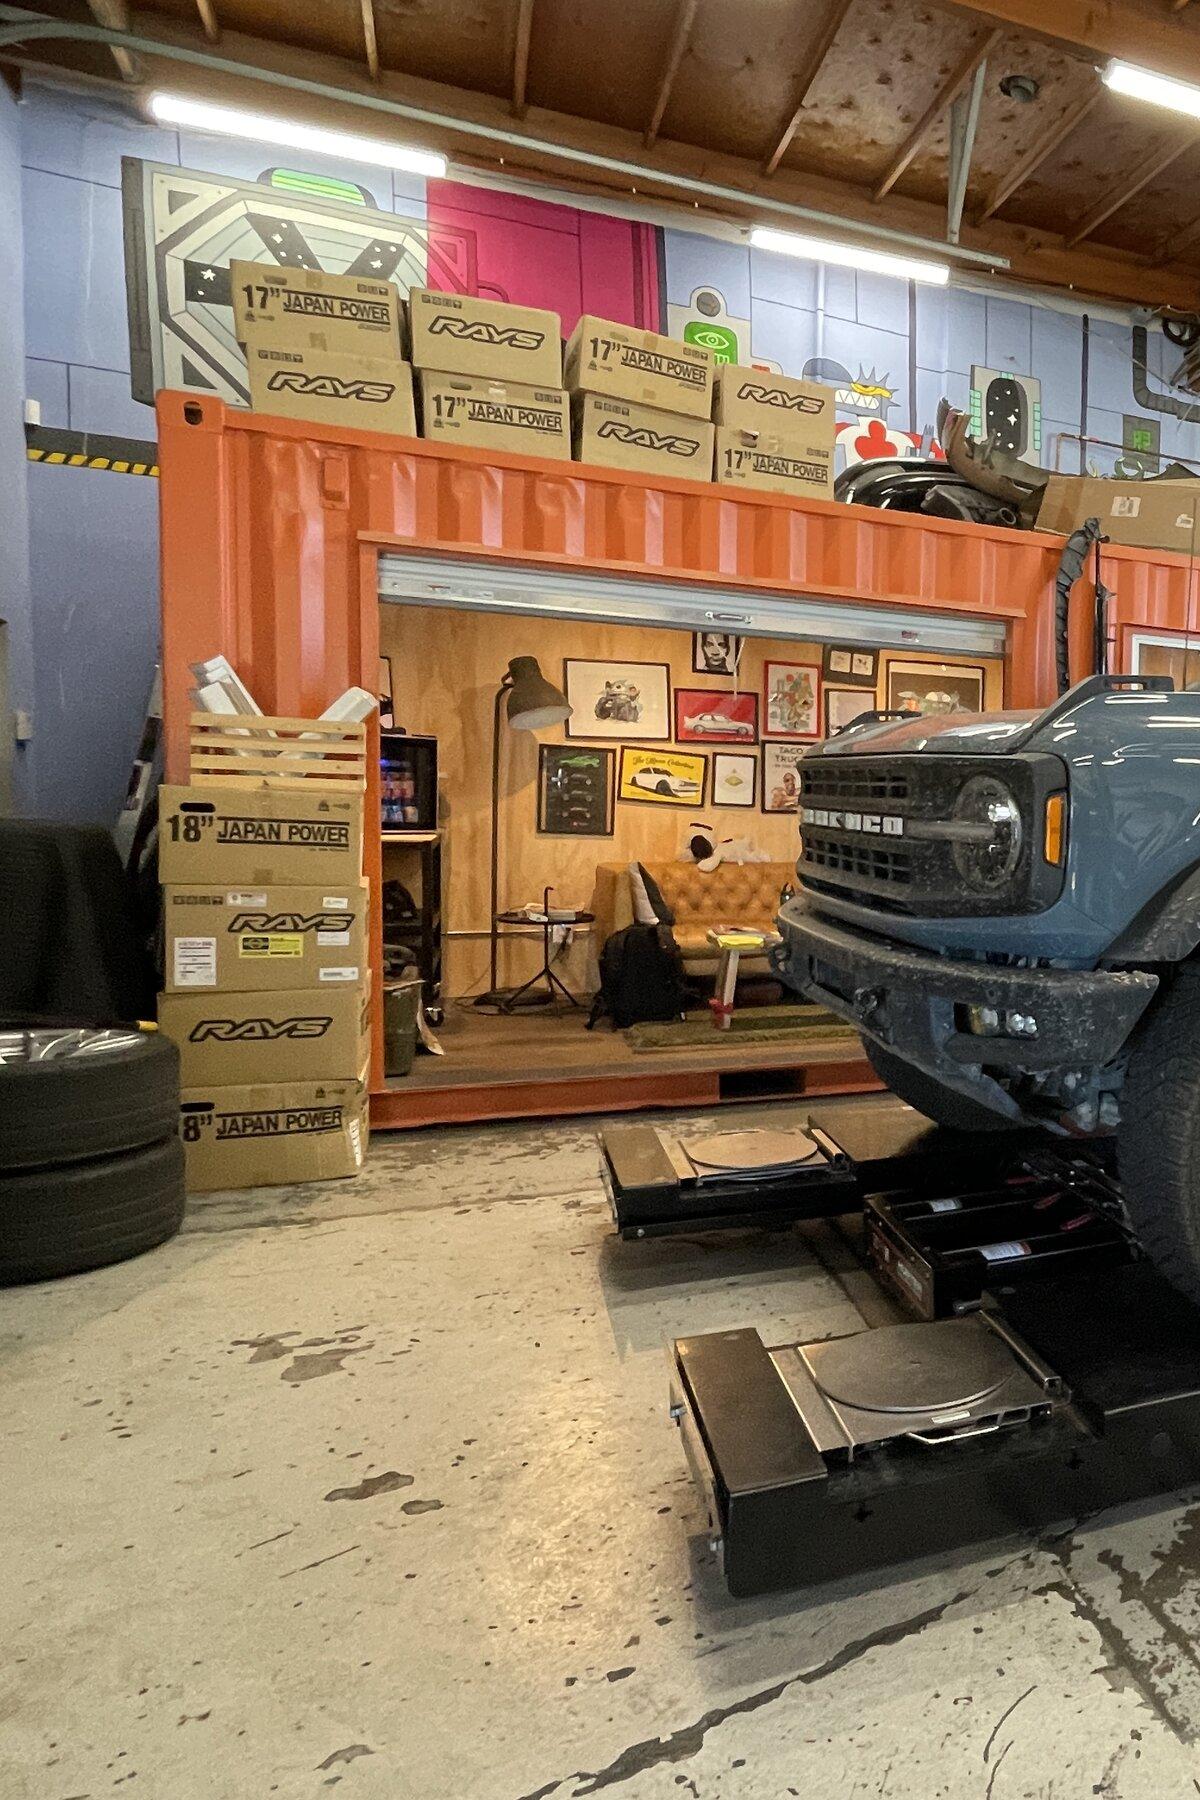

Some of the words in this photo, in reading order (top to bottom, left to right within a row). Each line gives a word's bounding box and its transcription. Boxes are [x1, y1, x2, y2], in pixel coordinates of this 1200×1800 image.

[242, 284, 281, 309] 17"
[283, 292, 334, 315] JAPAN
[340, 300, 391, 322] POWER
[428, 315, 545, 351] RAYS
[590, 337, 621, 359] 17"
[621, 347, 663, 371] JAPAN
[665, 359, 707, 384] POWER
[267, 370, 396, 402] RAYS
[737, 383, 824, 414] RAYS
[432, 395, 467, 418] 17"
[468, 401, 515, 424] JAPAN
[519, 408, 563, 430] POWER
[599, 420, 700, 457] RAYS
[723, 448, 752, 470] 17"
[753, 454, 789, 477] JAPAN
[792, 459, 829, 483] POWER
[775, 754, 798, 763] TRUC
[778, 746, 803, 755] TACO
[166, 815, 214, 843] 18"
[217, 819, 282, 841] JAPAN
[288, 823, 350, 843] POWER
[228, 912, 356, 932] RAYS
[189, 1016, 333, 1042] RAYS
[181, 1115, 213, 1142] 8"
[216, 1114, 278, 1136] JAPAN
[285, 1110, 343, 1132] POWER
